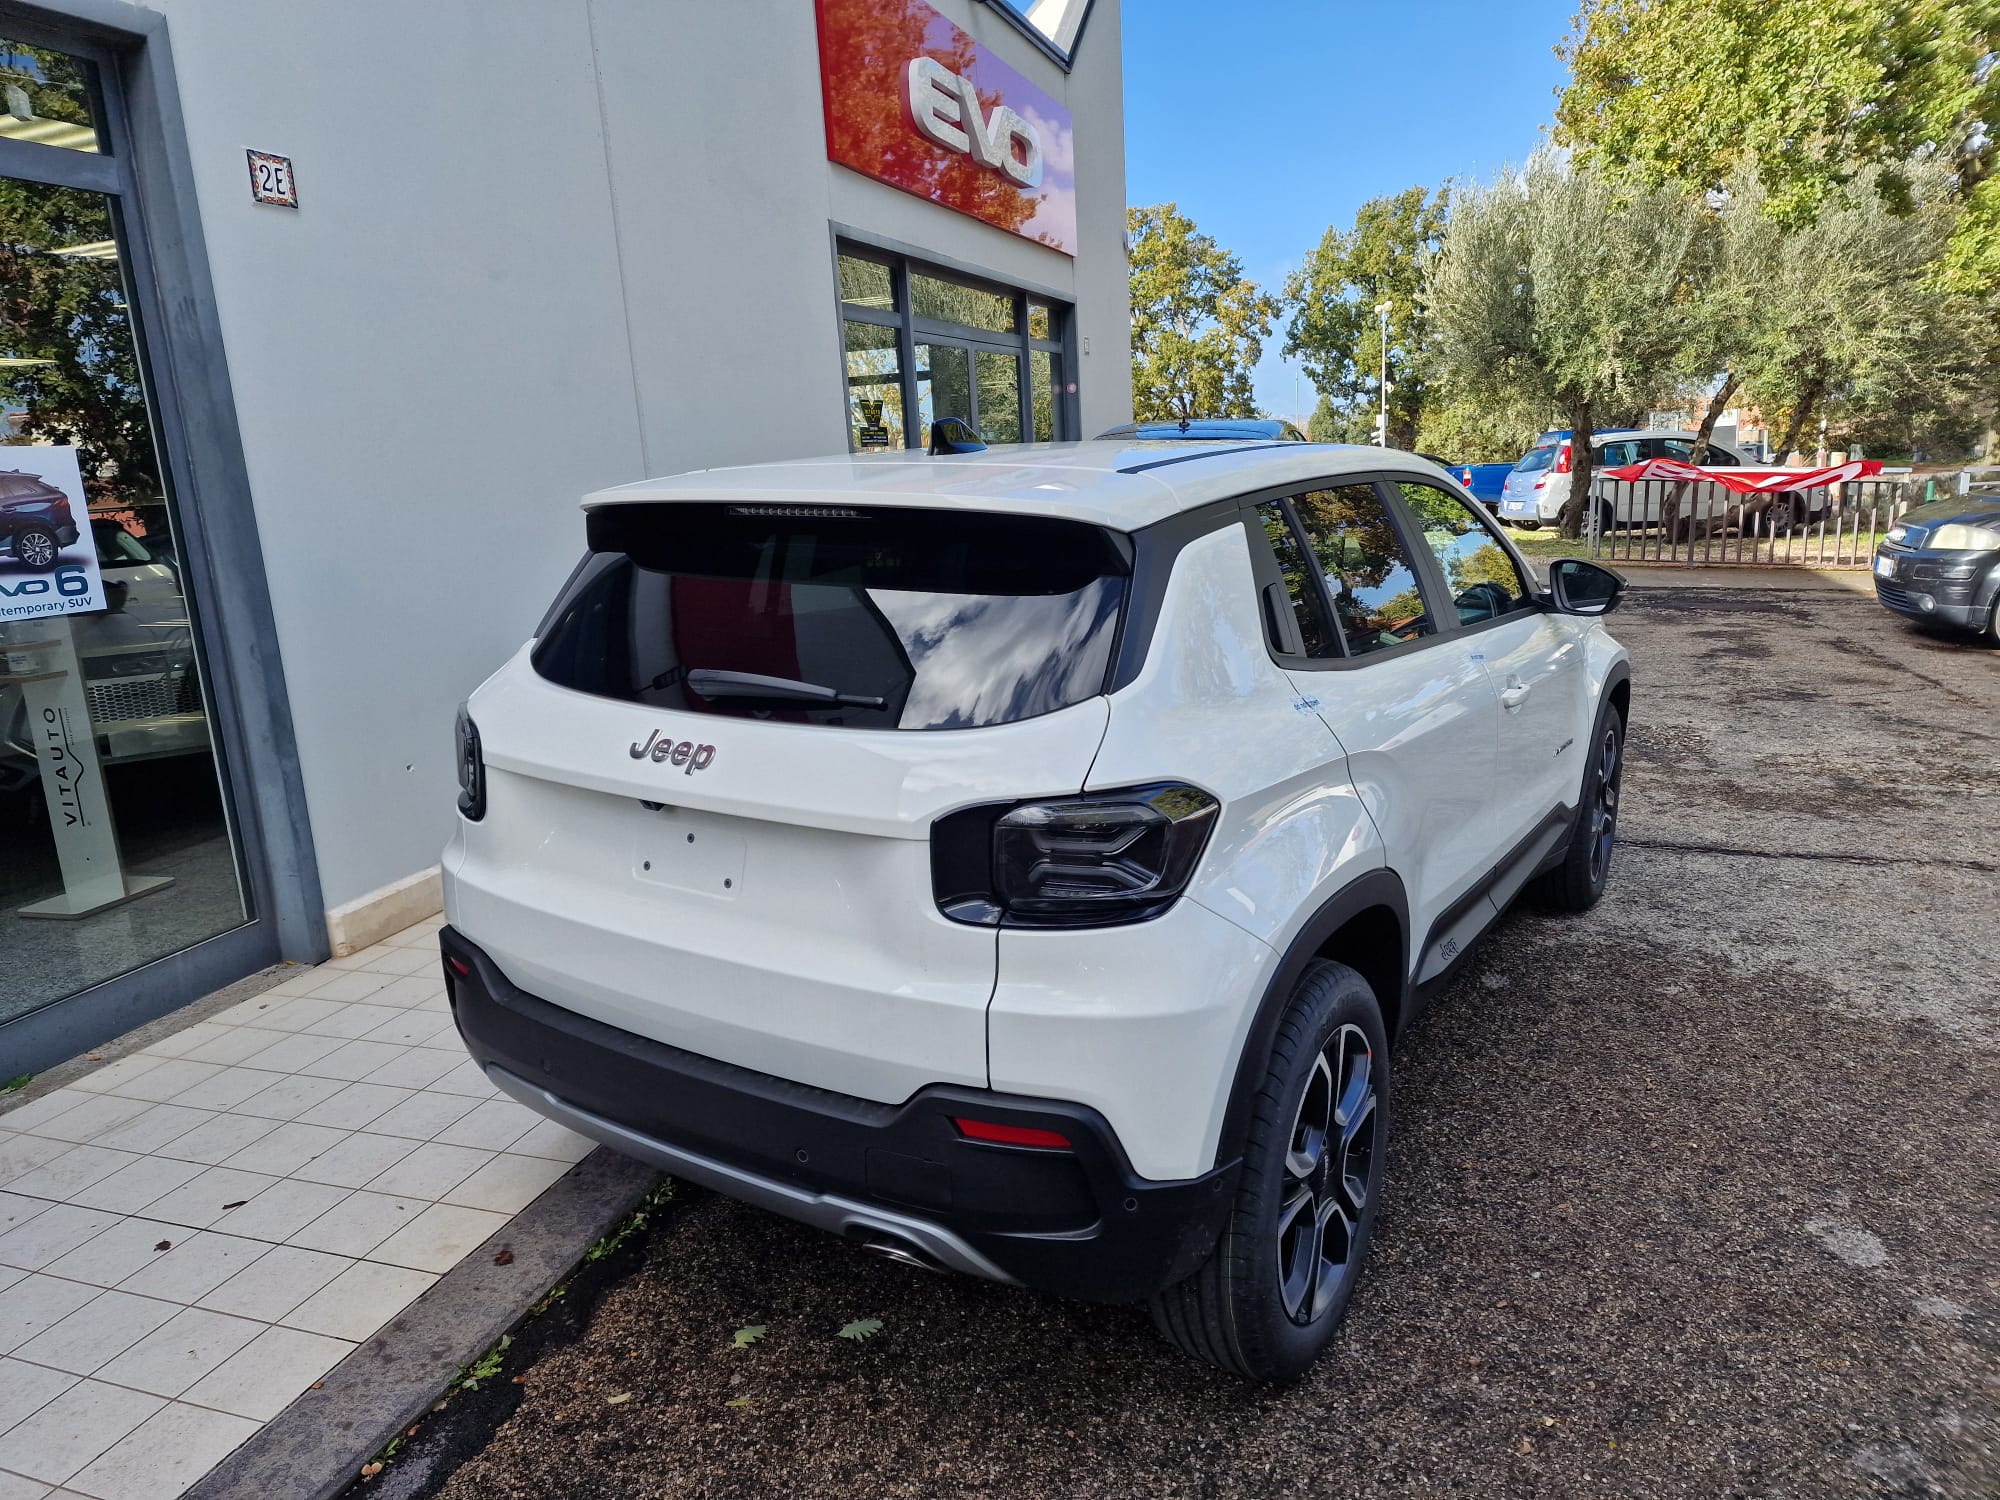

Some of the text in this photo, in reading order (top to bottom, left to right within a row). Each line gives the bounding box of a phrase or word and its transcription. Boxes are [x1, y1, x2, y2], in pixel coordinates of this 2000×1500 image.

[909, 56, 1043, 189] EVO
[259, 164, 286, 195] 2E
[54, 564, 89, 597] 6
[0, 597, 92, 617] temporary SUV
[43, 707, 78, 827] VITAUTO
[629, 728, 717, 776] Jeep
